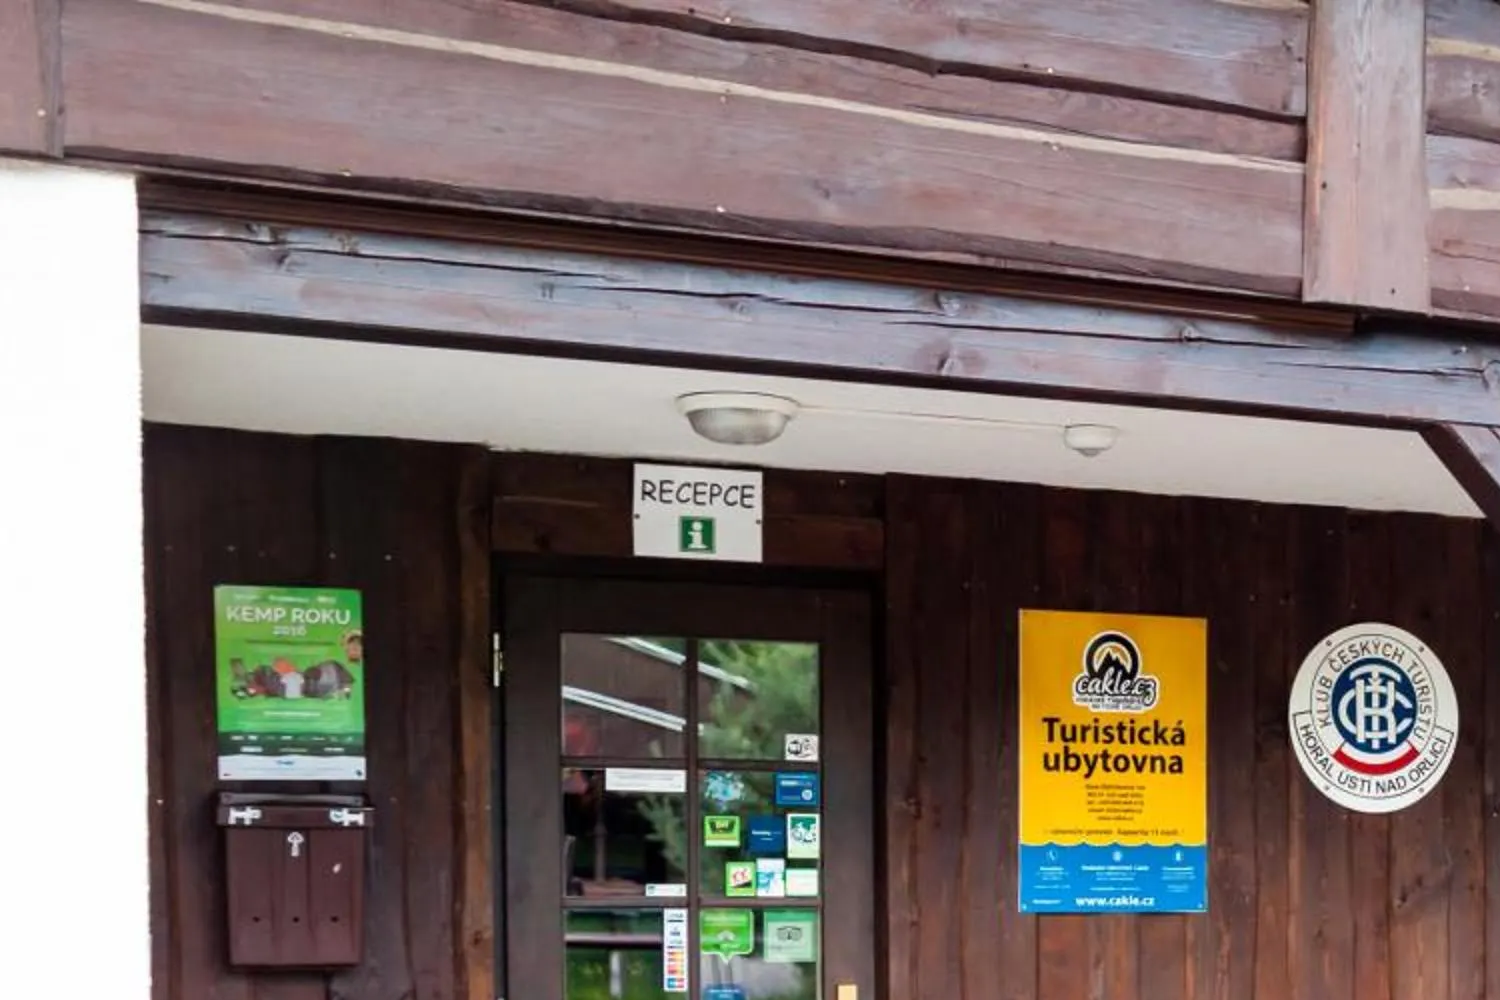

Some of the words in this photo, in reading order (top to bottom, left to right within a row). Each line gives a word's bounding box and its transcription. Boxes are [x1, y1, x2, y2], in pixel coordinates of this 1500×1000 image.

[641, 479, 756, 509] RECEPCE
[226, 606, 286, 624] KEMP
[292, 608, 351, 625] ROKU
[1315, 677, 1333, 729] KLUB
[1042, 717, 1186, 746] Turistická
[1043, 745, 1184, 779] ubytovna
[1300, 723, 1334, 778] HORAL
[1375, 778, 1407, 794] NAD
[1075, 896, 1155, 907] www.cakle.cz
